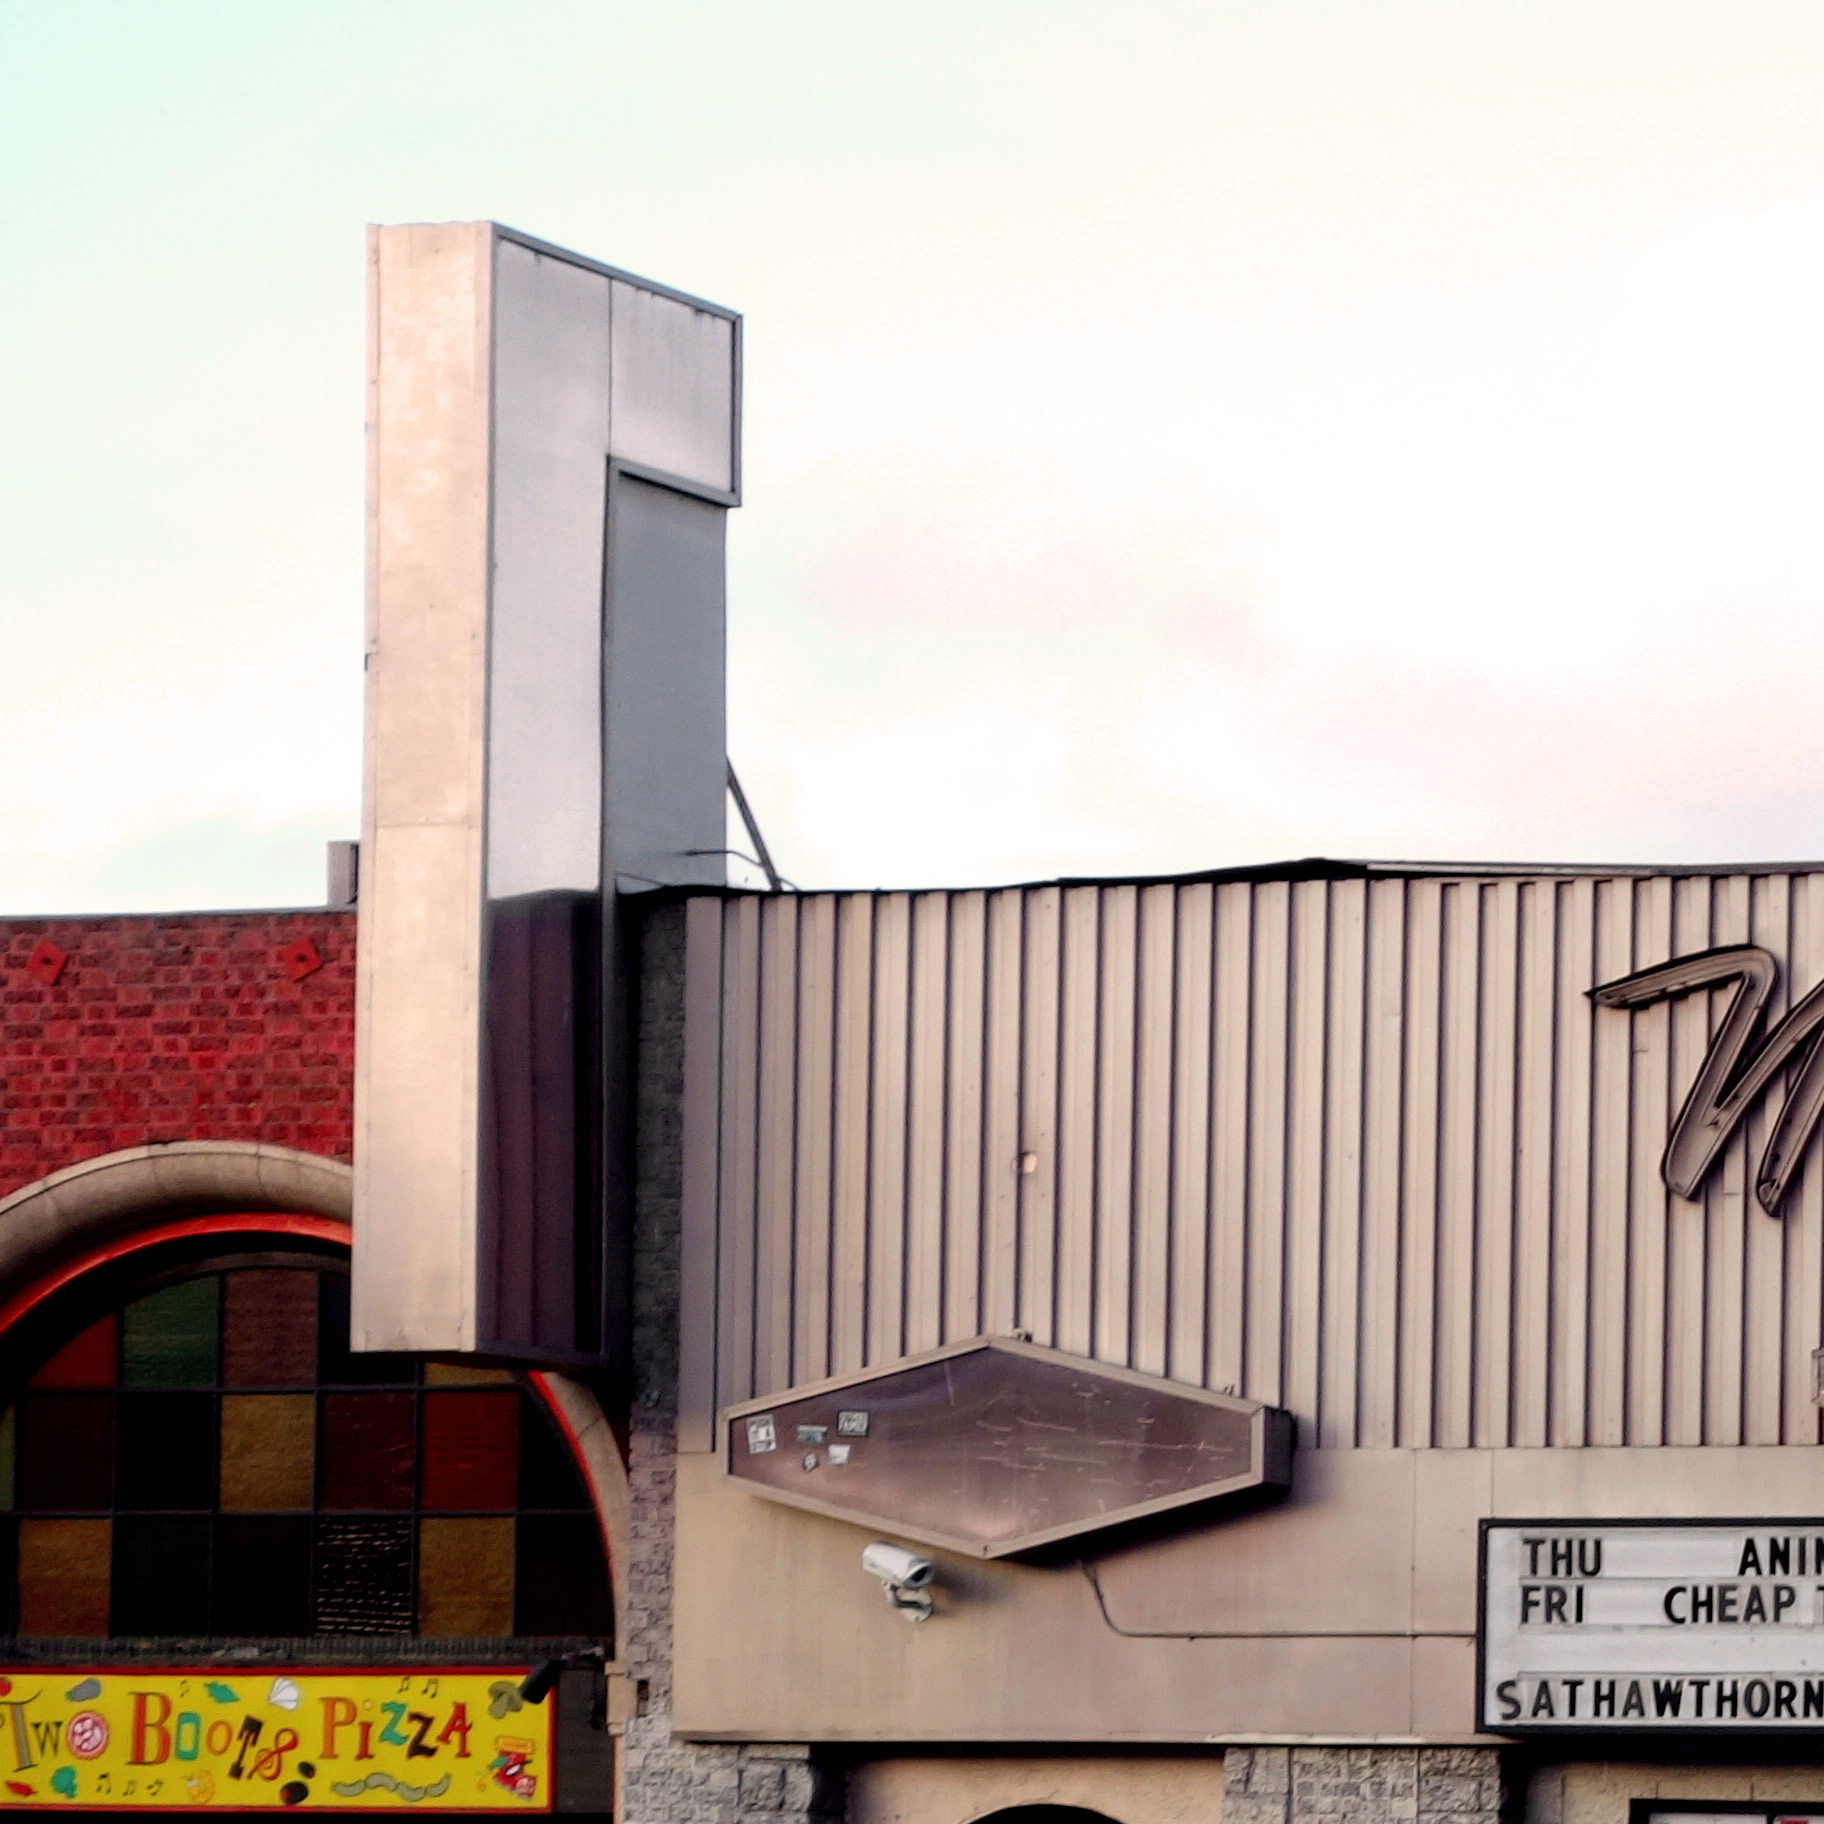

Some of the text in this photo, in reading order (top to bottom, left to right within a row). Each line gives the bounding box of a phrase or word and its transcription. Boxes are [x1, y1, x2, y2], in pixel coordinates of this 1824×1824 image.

[1523, 1537, 1602, 1576] THU
[1520, 1585, 1584, 1624] FRI
[1663, 1585, 1797, 1624] CHEAP
